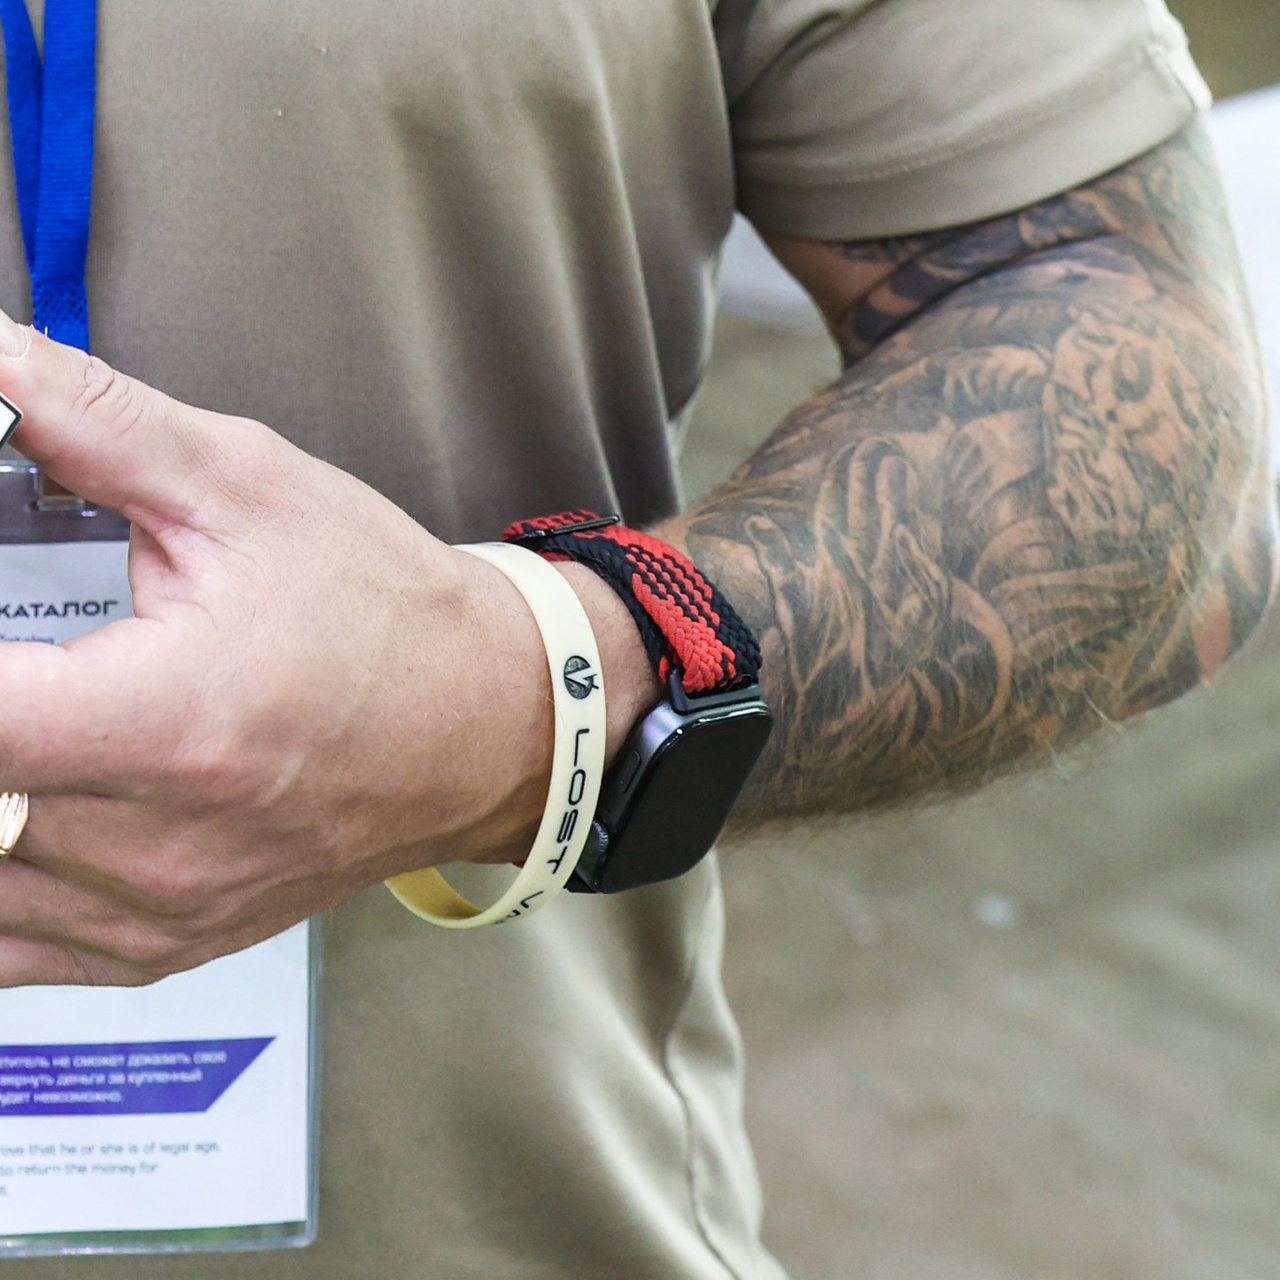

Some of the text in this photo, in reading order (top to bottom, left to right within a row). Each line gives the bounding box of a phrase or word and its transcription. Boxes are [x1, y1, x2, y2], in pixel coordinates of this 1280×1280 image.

[546, 728, 590, 874] LOST
[29, 1145, 56, 1157] that
[100, 1143, 123, 1154] she
[160, 1142, 189, 1155] legal
[0, 1165, 13, 1176] to
[17, 1164, 62, 1175] return
[64, 1163, 87, 1174] the
[91, 1164, 135, 1177] money
[140, 1162, 158, 1173] for
